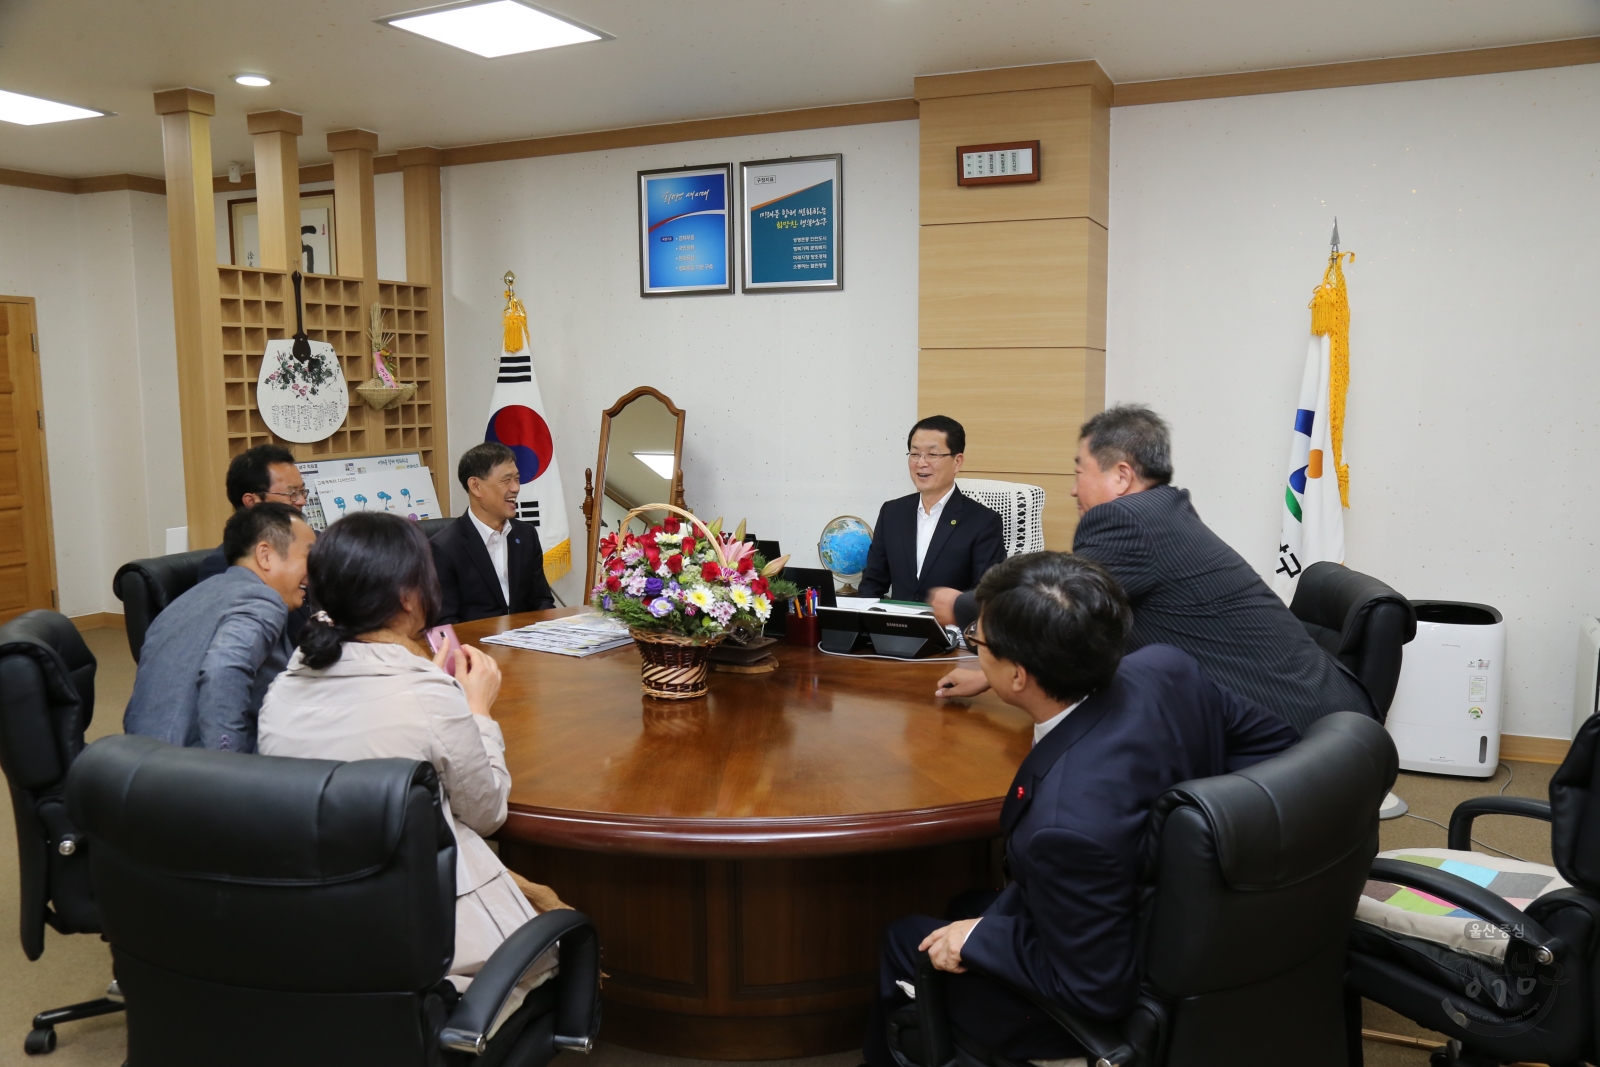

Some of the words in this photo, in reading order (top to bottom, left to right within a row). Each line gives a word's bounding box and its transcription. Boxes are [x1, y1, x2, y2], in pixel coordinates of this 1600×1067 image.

[759, 209, 780, 218] 미래를
[781, 208, 796, 218] 향해
[798, 207, 826, 216] 변화하는
[776, 220, 798, 229] 희망찬
[799, 218, 827, 227] 행복남구
